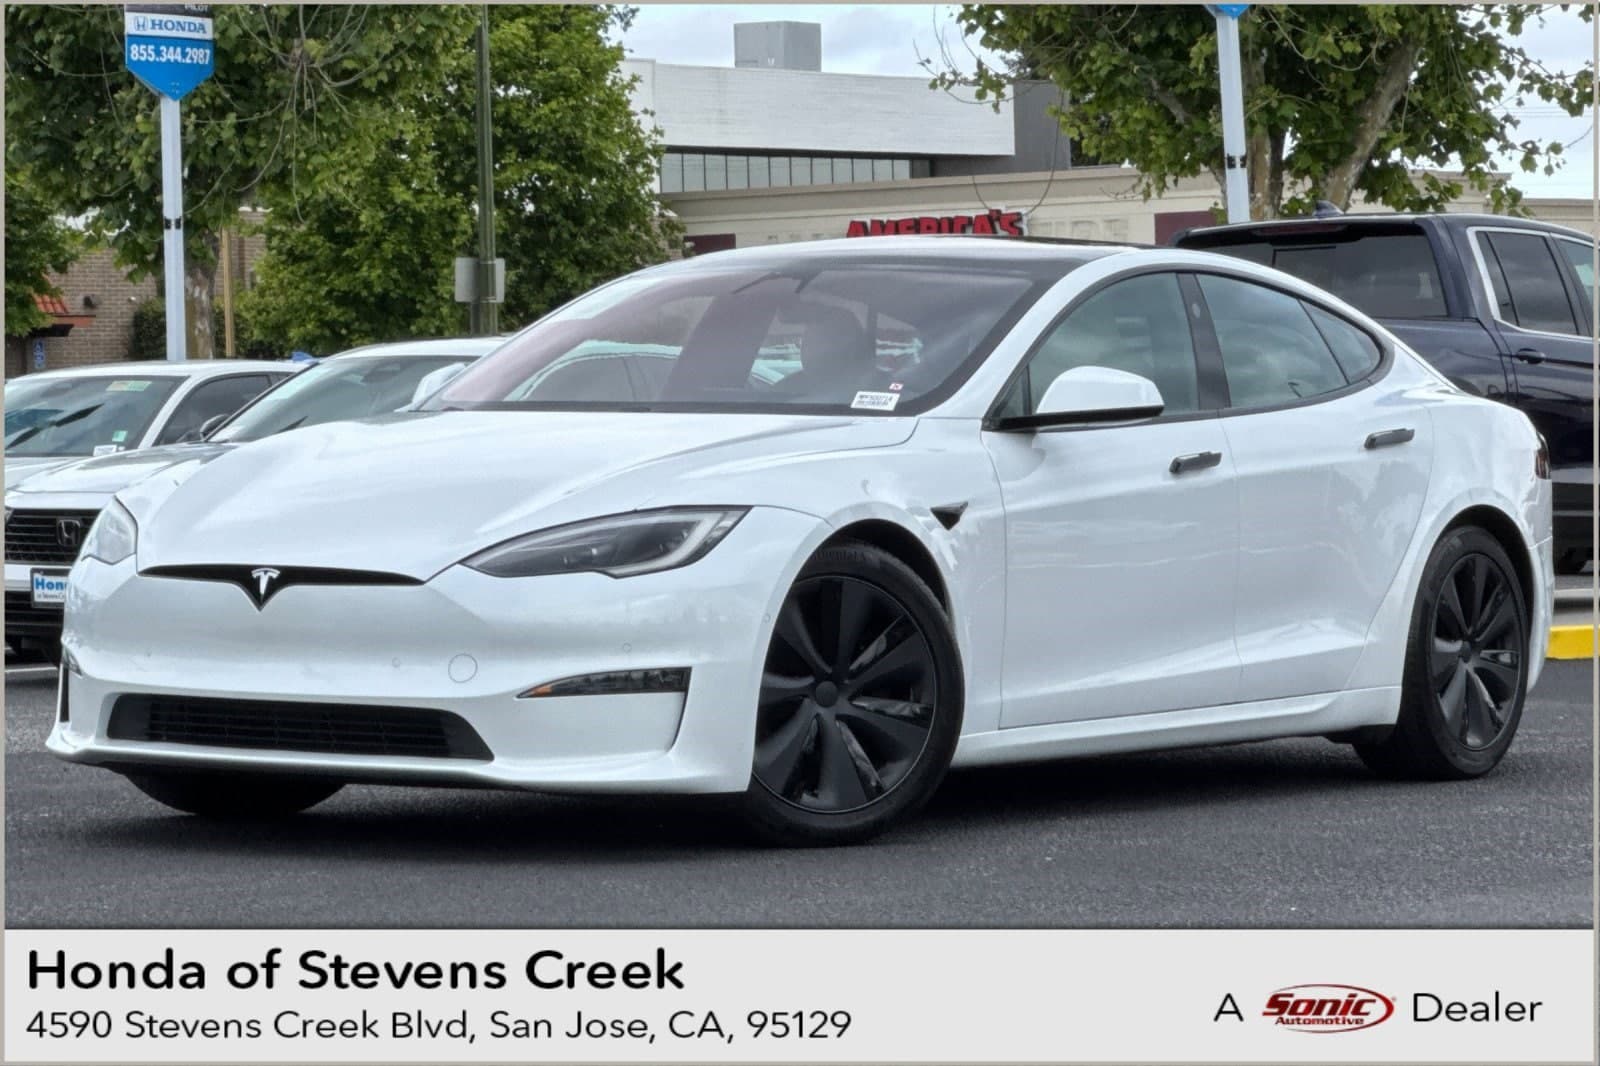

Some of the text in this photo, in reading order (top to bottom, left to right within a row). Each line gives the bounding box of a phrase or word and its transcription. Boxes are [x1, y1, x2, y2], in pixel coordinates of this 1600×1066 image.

[150, 19, 207, 34] HONDA
[130, 44, 210, 65] 855.344.2987
[846, 208, 1023, 238] AMERICA'S
[35, 578, 67, 591] Hon
